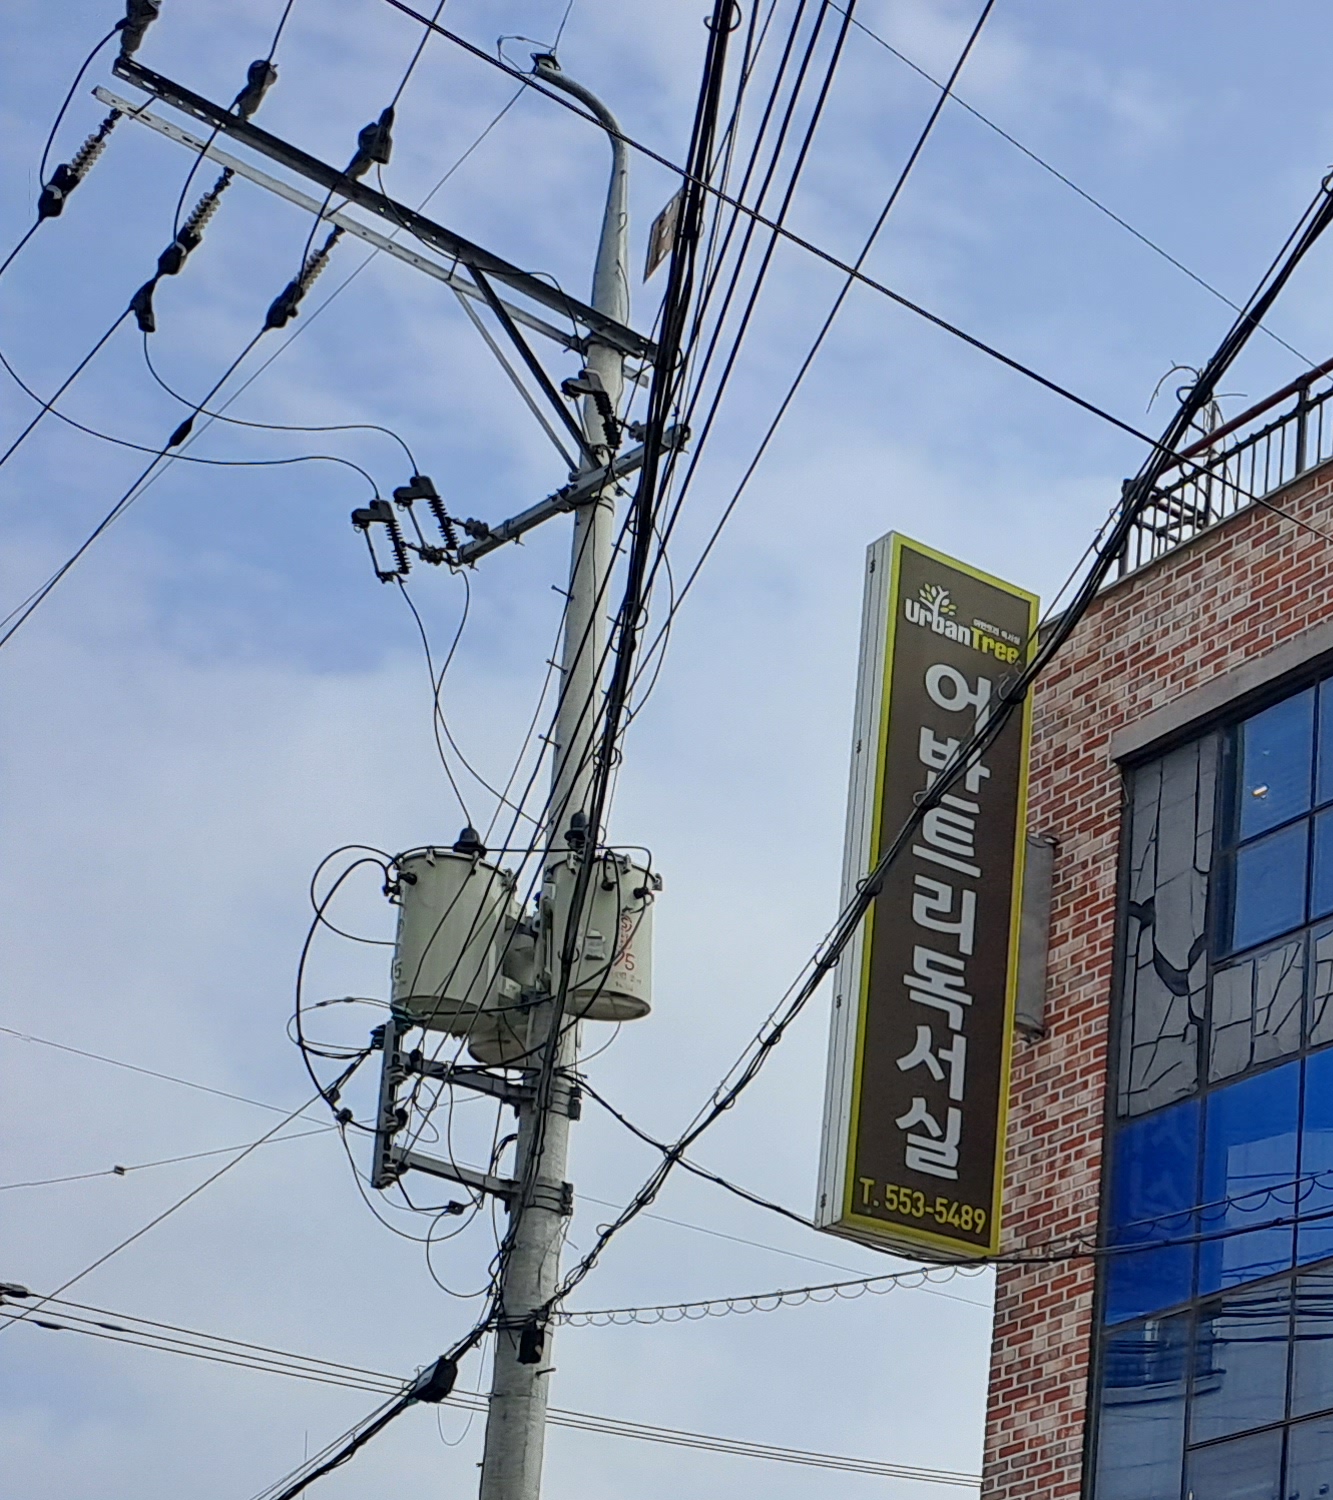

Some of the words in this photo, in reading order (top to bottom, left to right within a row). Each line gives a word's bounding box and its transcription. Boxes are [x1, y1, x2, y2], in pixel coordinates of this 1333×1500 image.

[905, 597, 1020, 665] UrbanTree
[860, 1177, 880, 1207] T.
[885, 1184, 986, 1234] 553-5489
